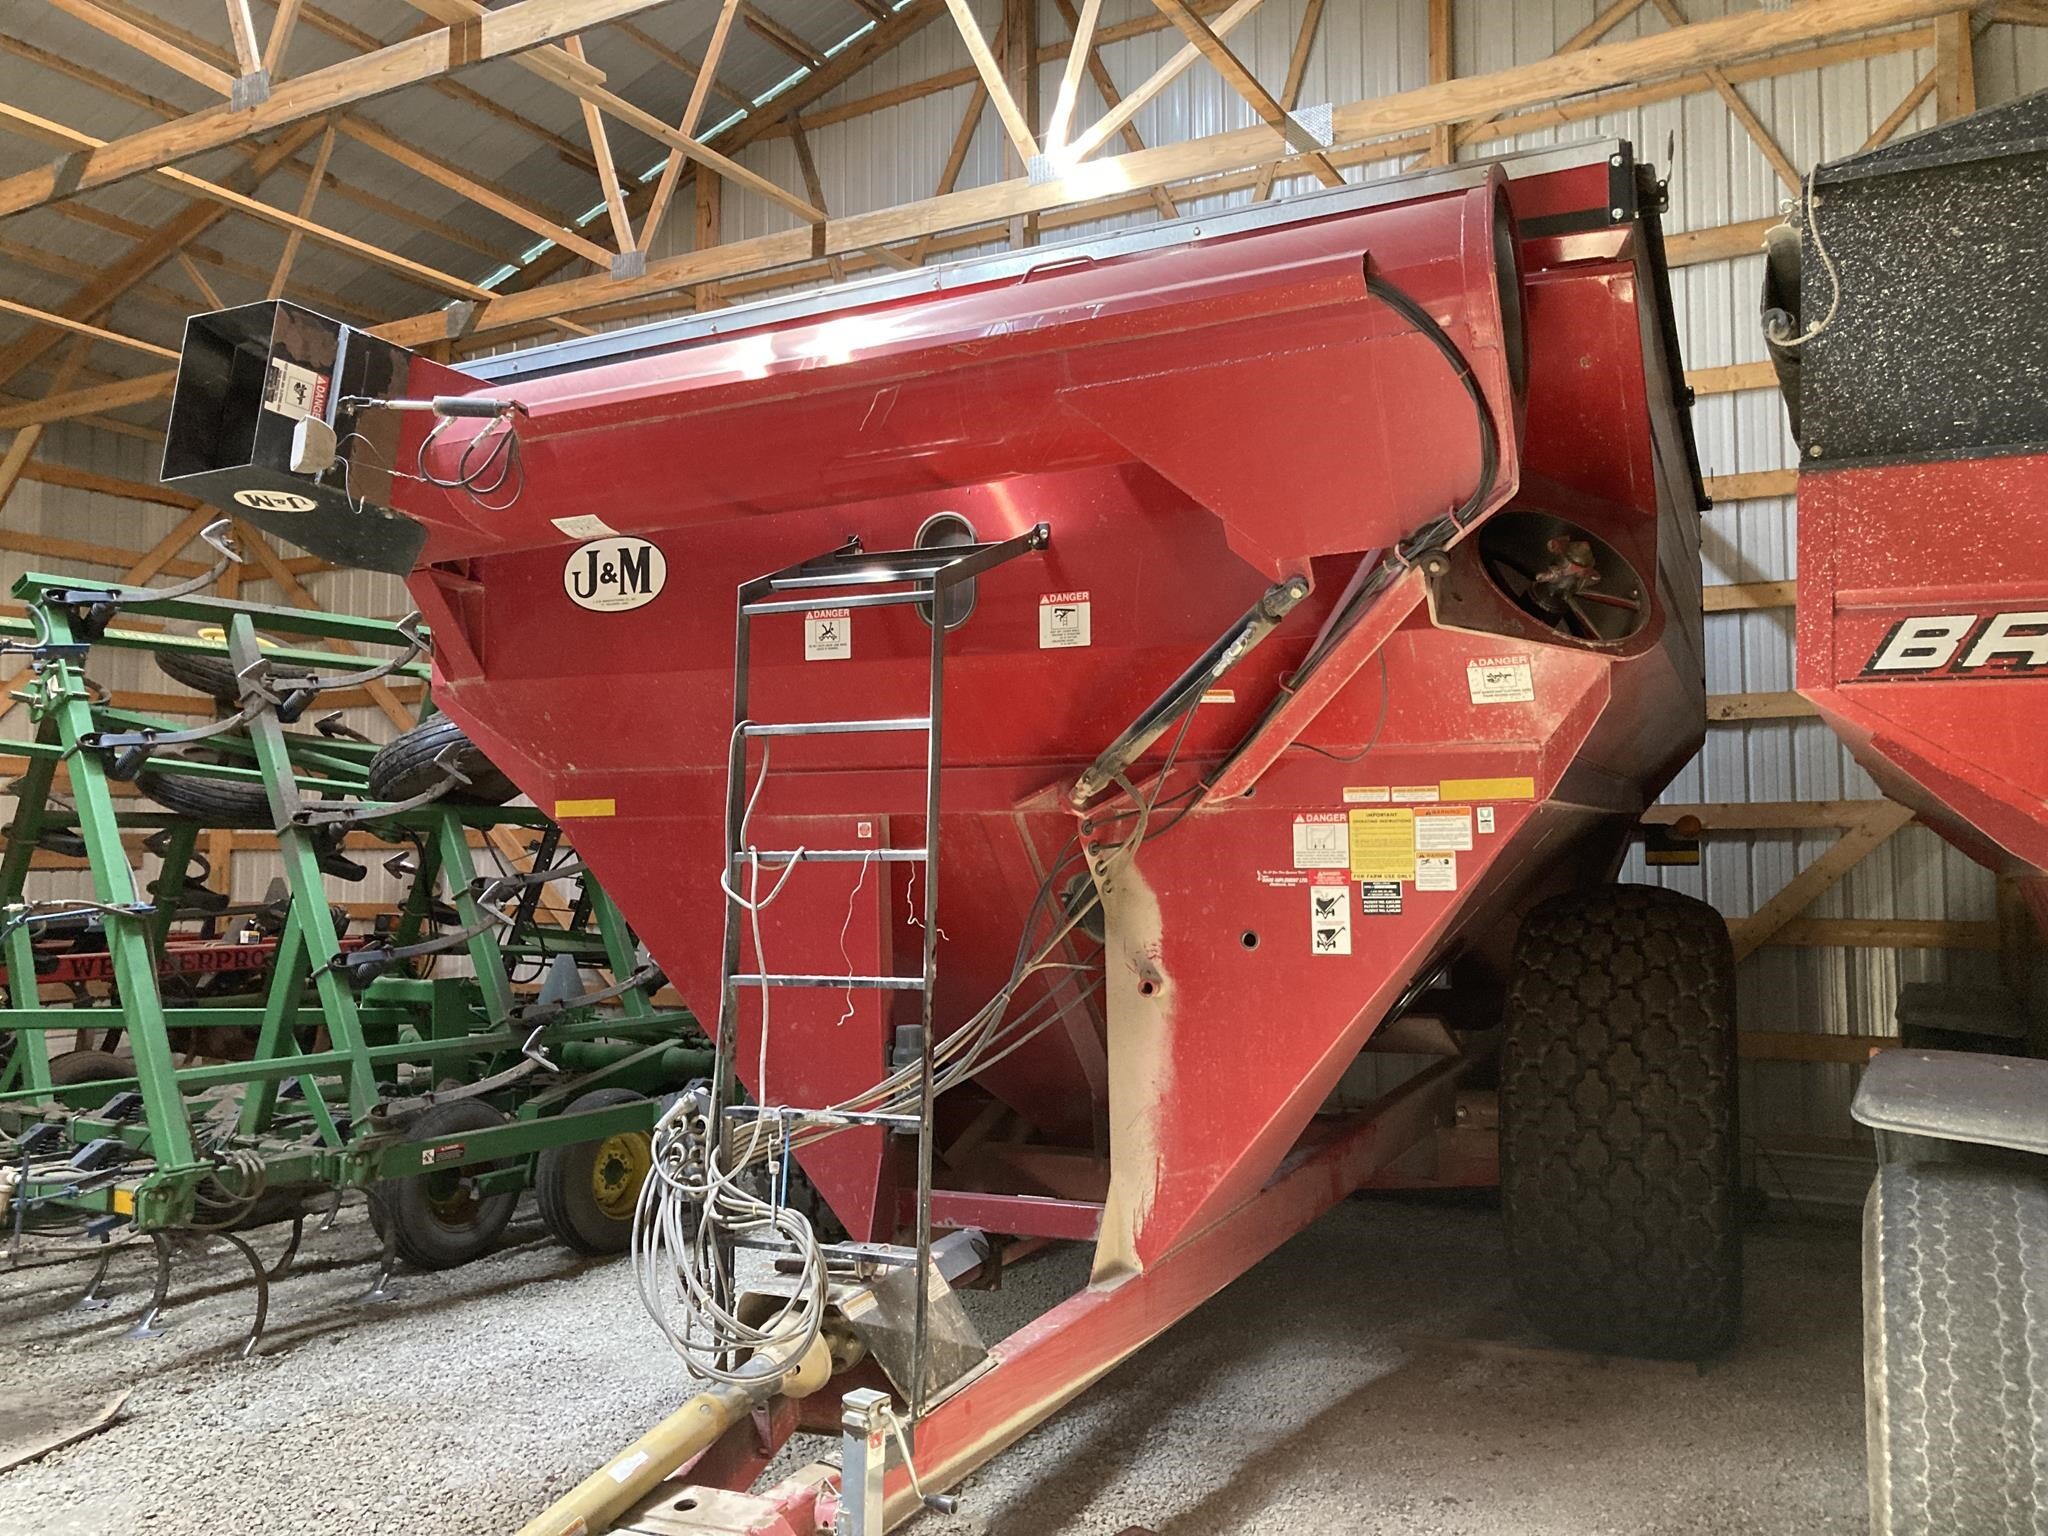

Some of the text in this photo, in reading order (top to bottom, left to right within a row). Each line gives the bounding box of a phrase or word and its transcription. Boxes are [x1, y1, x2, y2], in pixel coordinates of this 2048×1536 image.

[311, 385, 327, 419] DANGE
[571, 545, 653, 599] J&M
[1050, 591, 1090, 603] DANGER
[813, 608, 850, 619] DANGER
[1478, 655, 1528, 667] DANGER
[1305, 813, 1347, 823] DANGER
[71, 950, 266, 979] WEERPRO
